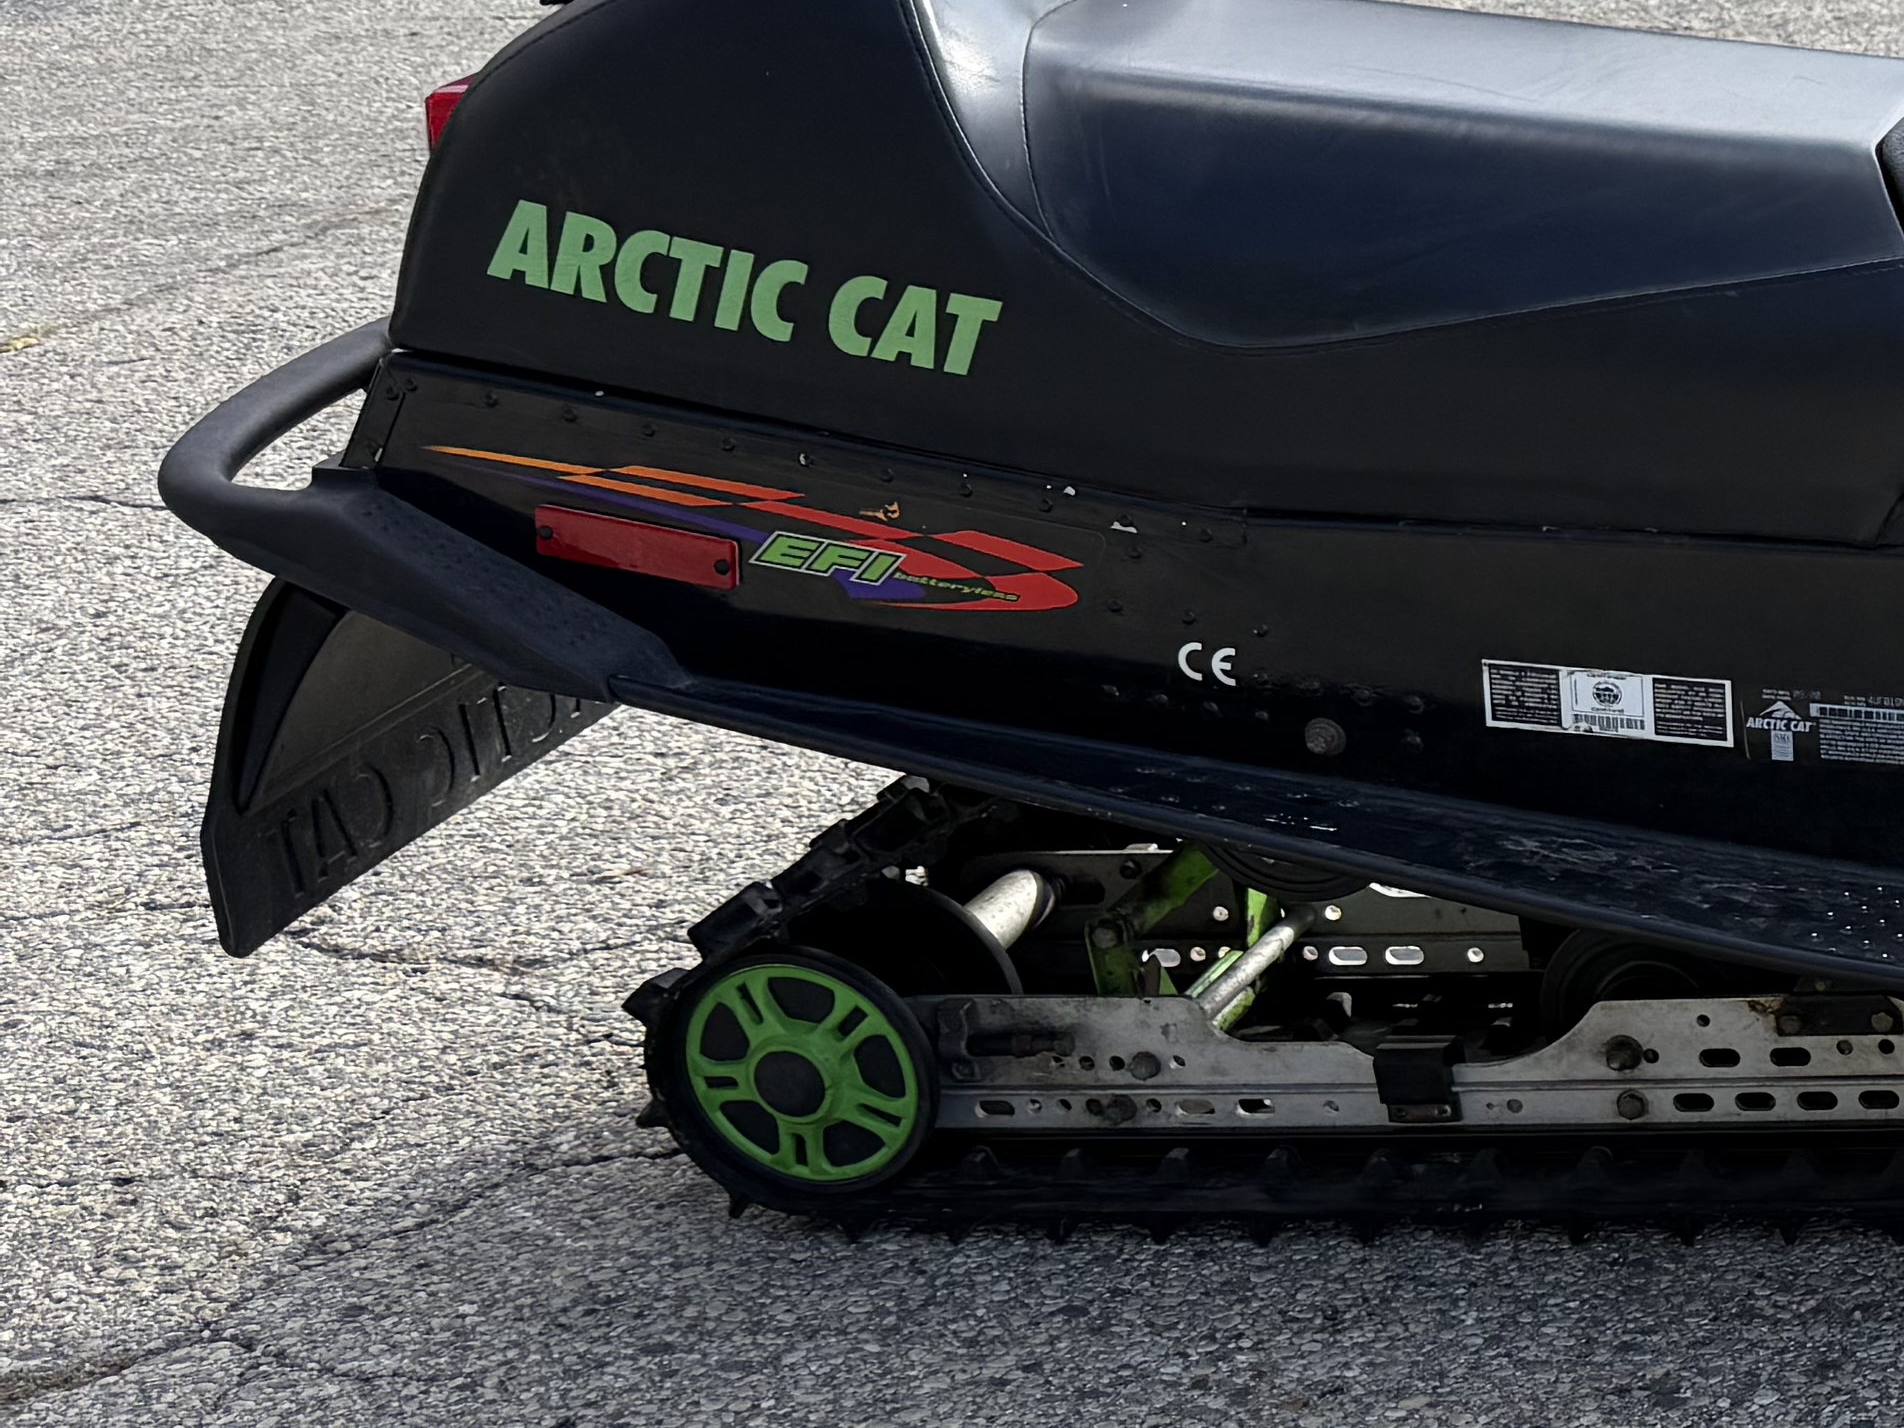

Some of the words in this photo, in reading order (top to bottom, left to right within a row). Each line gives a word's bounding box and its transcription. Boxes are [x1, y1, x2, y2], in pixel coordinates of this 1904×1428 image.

[486, 199, 808, 343] ARCTIC
[828, 275, 1003, 375] CAT
[749, 531, 907, 586] EFI
[893, 571, 1021, 602] batteryless
[1178, 641, 1237, 687] CE
[1746, 716, 1787, 730] ARCTIC
[1790, 717, 1812, 732] CAT
